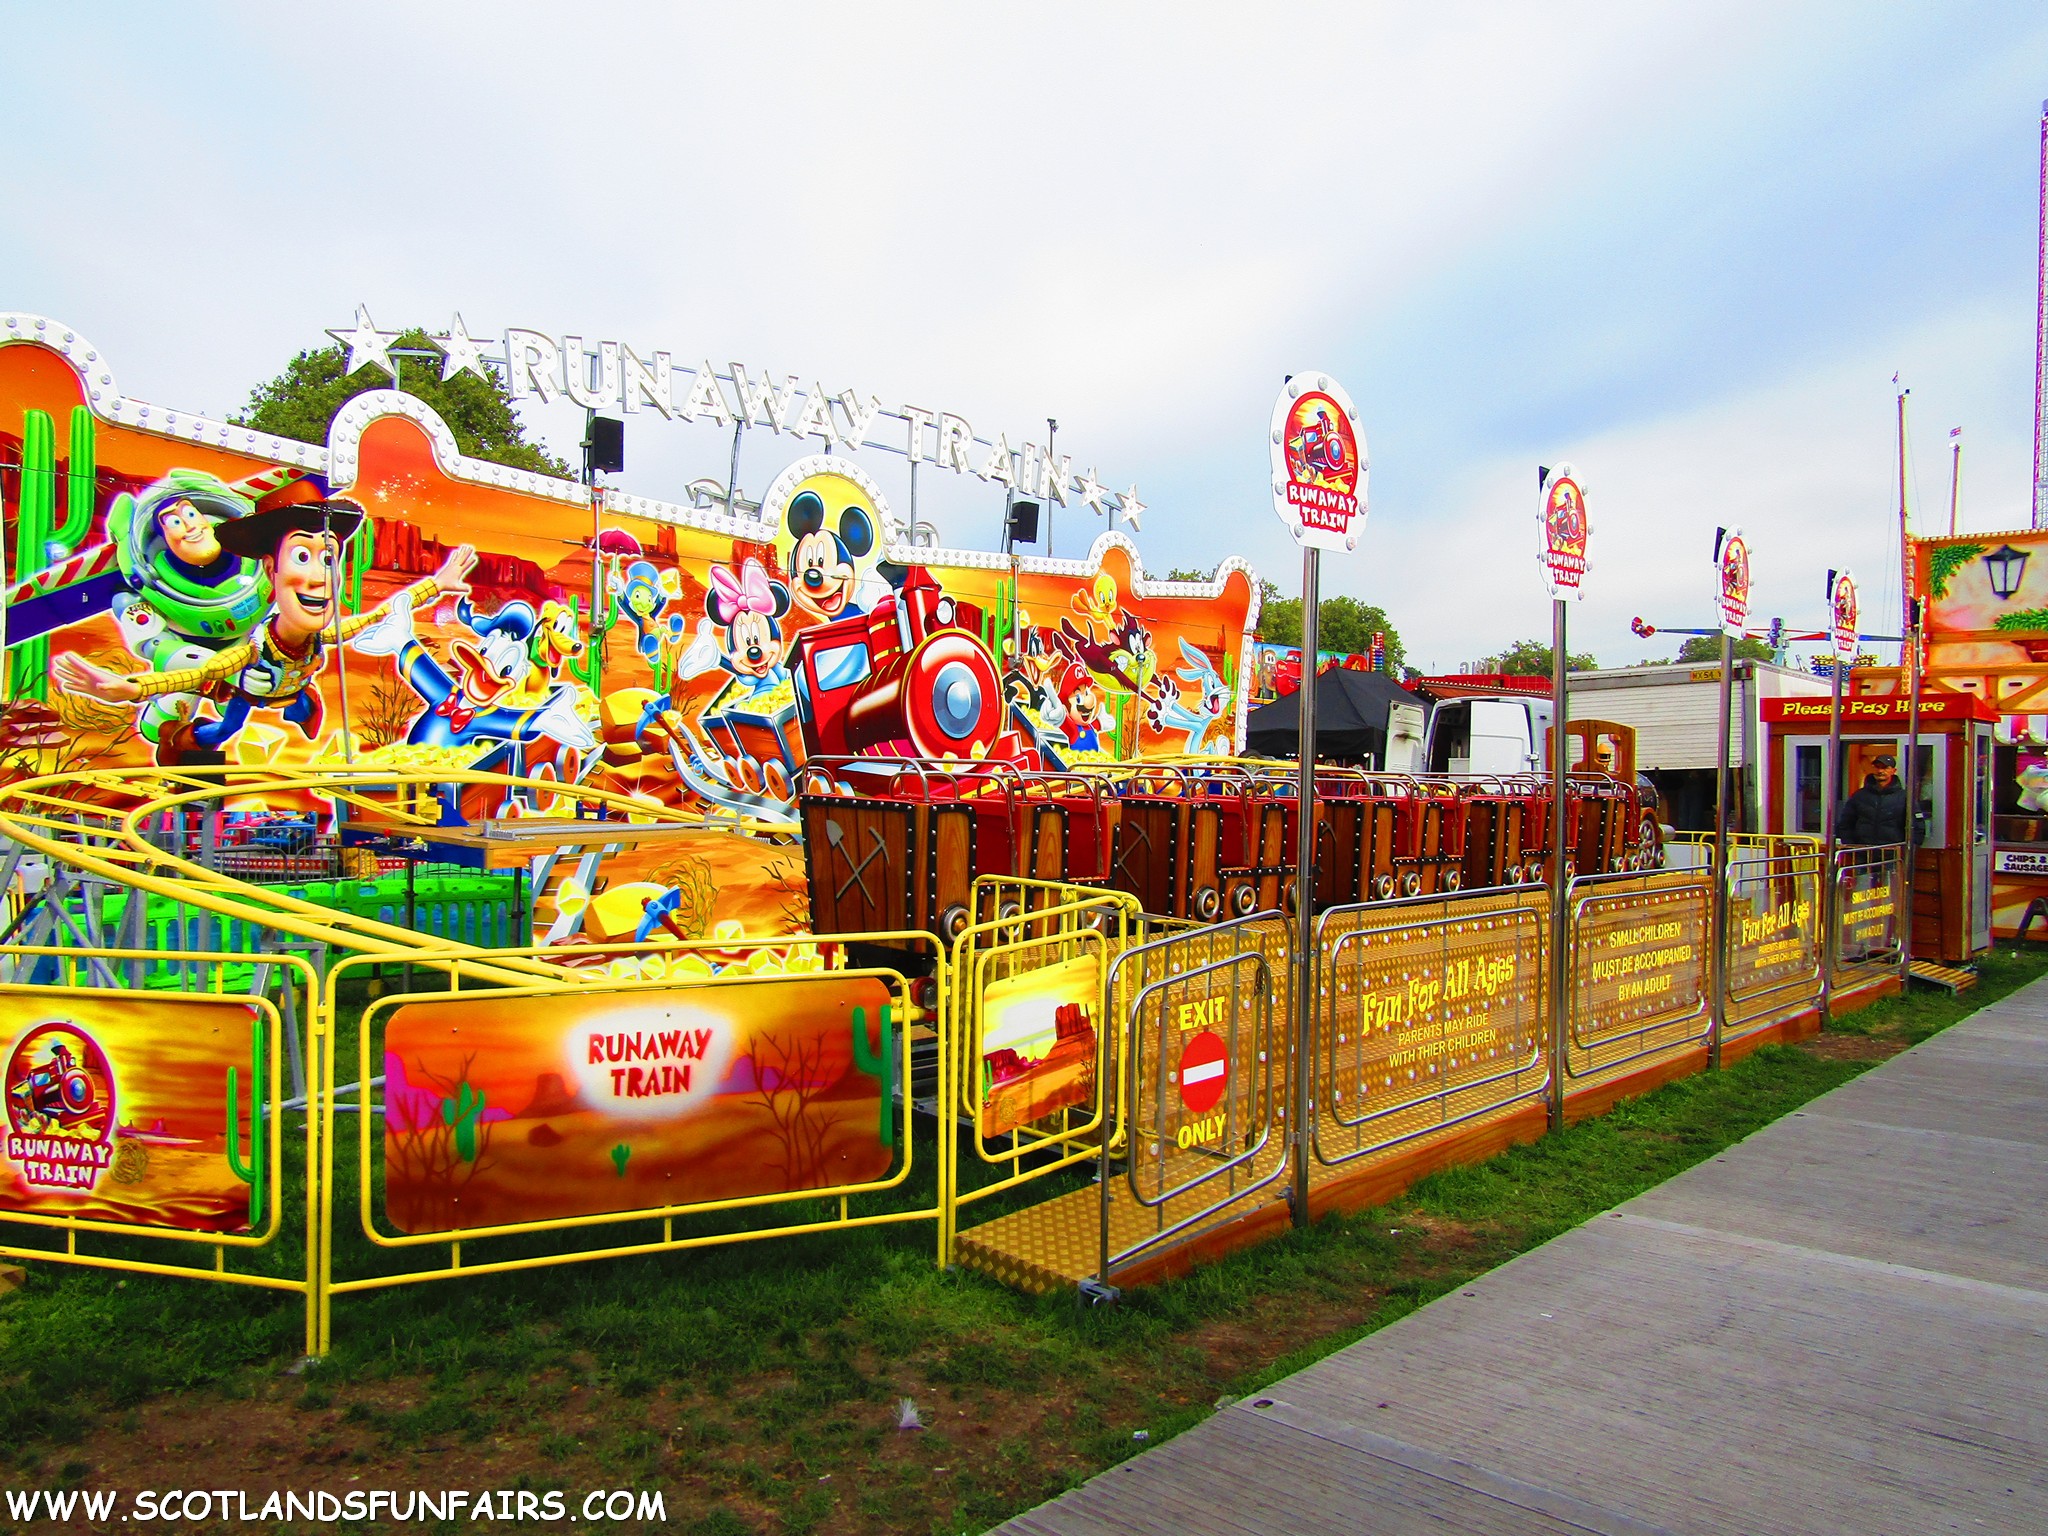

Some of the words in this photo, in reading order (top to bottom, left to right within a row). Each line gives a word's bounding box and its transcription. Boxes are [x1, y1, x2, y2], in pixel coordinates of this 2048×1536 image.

[505, 327, 882, 452] RUNAWAY
[900, 404, 1071, 508] TRAIN
[1289, 485, 1356, 513] RUNAWAY
[1301, 507, 1346, 529] TRAIN
[1547, 552, 1586, 572] RUNAWAY
[1554, 568, 1580, 585] TRAIN
[1782, 702, 1845, 716] Please
[1849, 701, 1890, 716] Pay
[2006, 854, 2036, 864] CHIPS
[1609, 928, 1638, 949] SMALL
[1639, 921, 1682, 943] CHILDREN
[1742, 918, 1760, 946] Fun
[1777, 902, 1790, 929] All
[1592, 958, 1621, 979] MUST
[1622, 955, 1634, 973] BE
[1634, 944, 1692, 972] ACCOMPANIED
[1361, 991, 1402, 1036] Fun
[1408, 977, 1439, 1020] For
[1443, 959, 1469, 1001] All
[1473, 955, 1514, 995] Ages
[1618, 982, 1631, 1001] BY
[1631, 980, 1643, 998] AN
[1644, 974, 1672, 995] ADULT
[1179, 995, 1226, 1031] EXIT
[1398, 1022, 1442, 1047] PARENTS
[1443, 1018, 1465, 1034] MAY
[1466, 1012, 1489, 1029] RIDE
[588, 1028, 713, 1065] RUNAWAY
[1389, 1048, 1416, 1068] WITH
[1417, 1041, 1446, 1059] THIER
[1447, 1028, 1496, 1052] CHILDREN
[610, 1065, 691, 1099] TRAIN
[1177, 1113, 1227, 1150] ONLY
[10, 1137, 111, 1164] RUNAWAY
[27, 1161, 94, 1184] TRAIN
